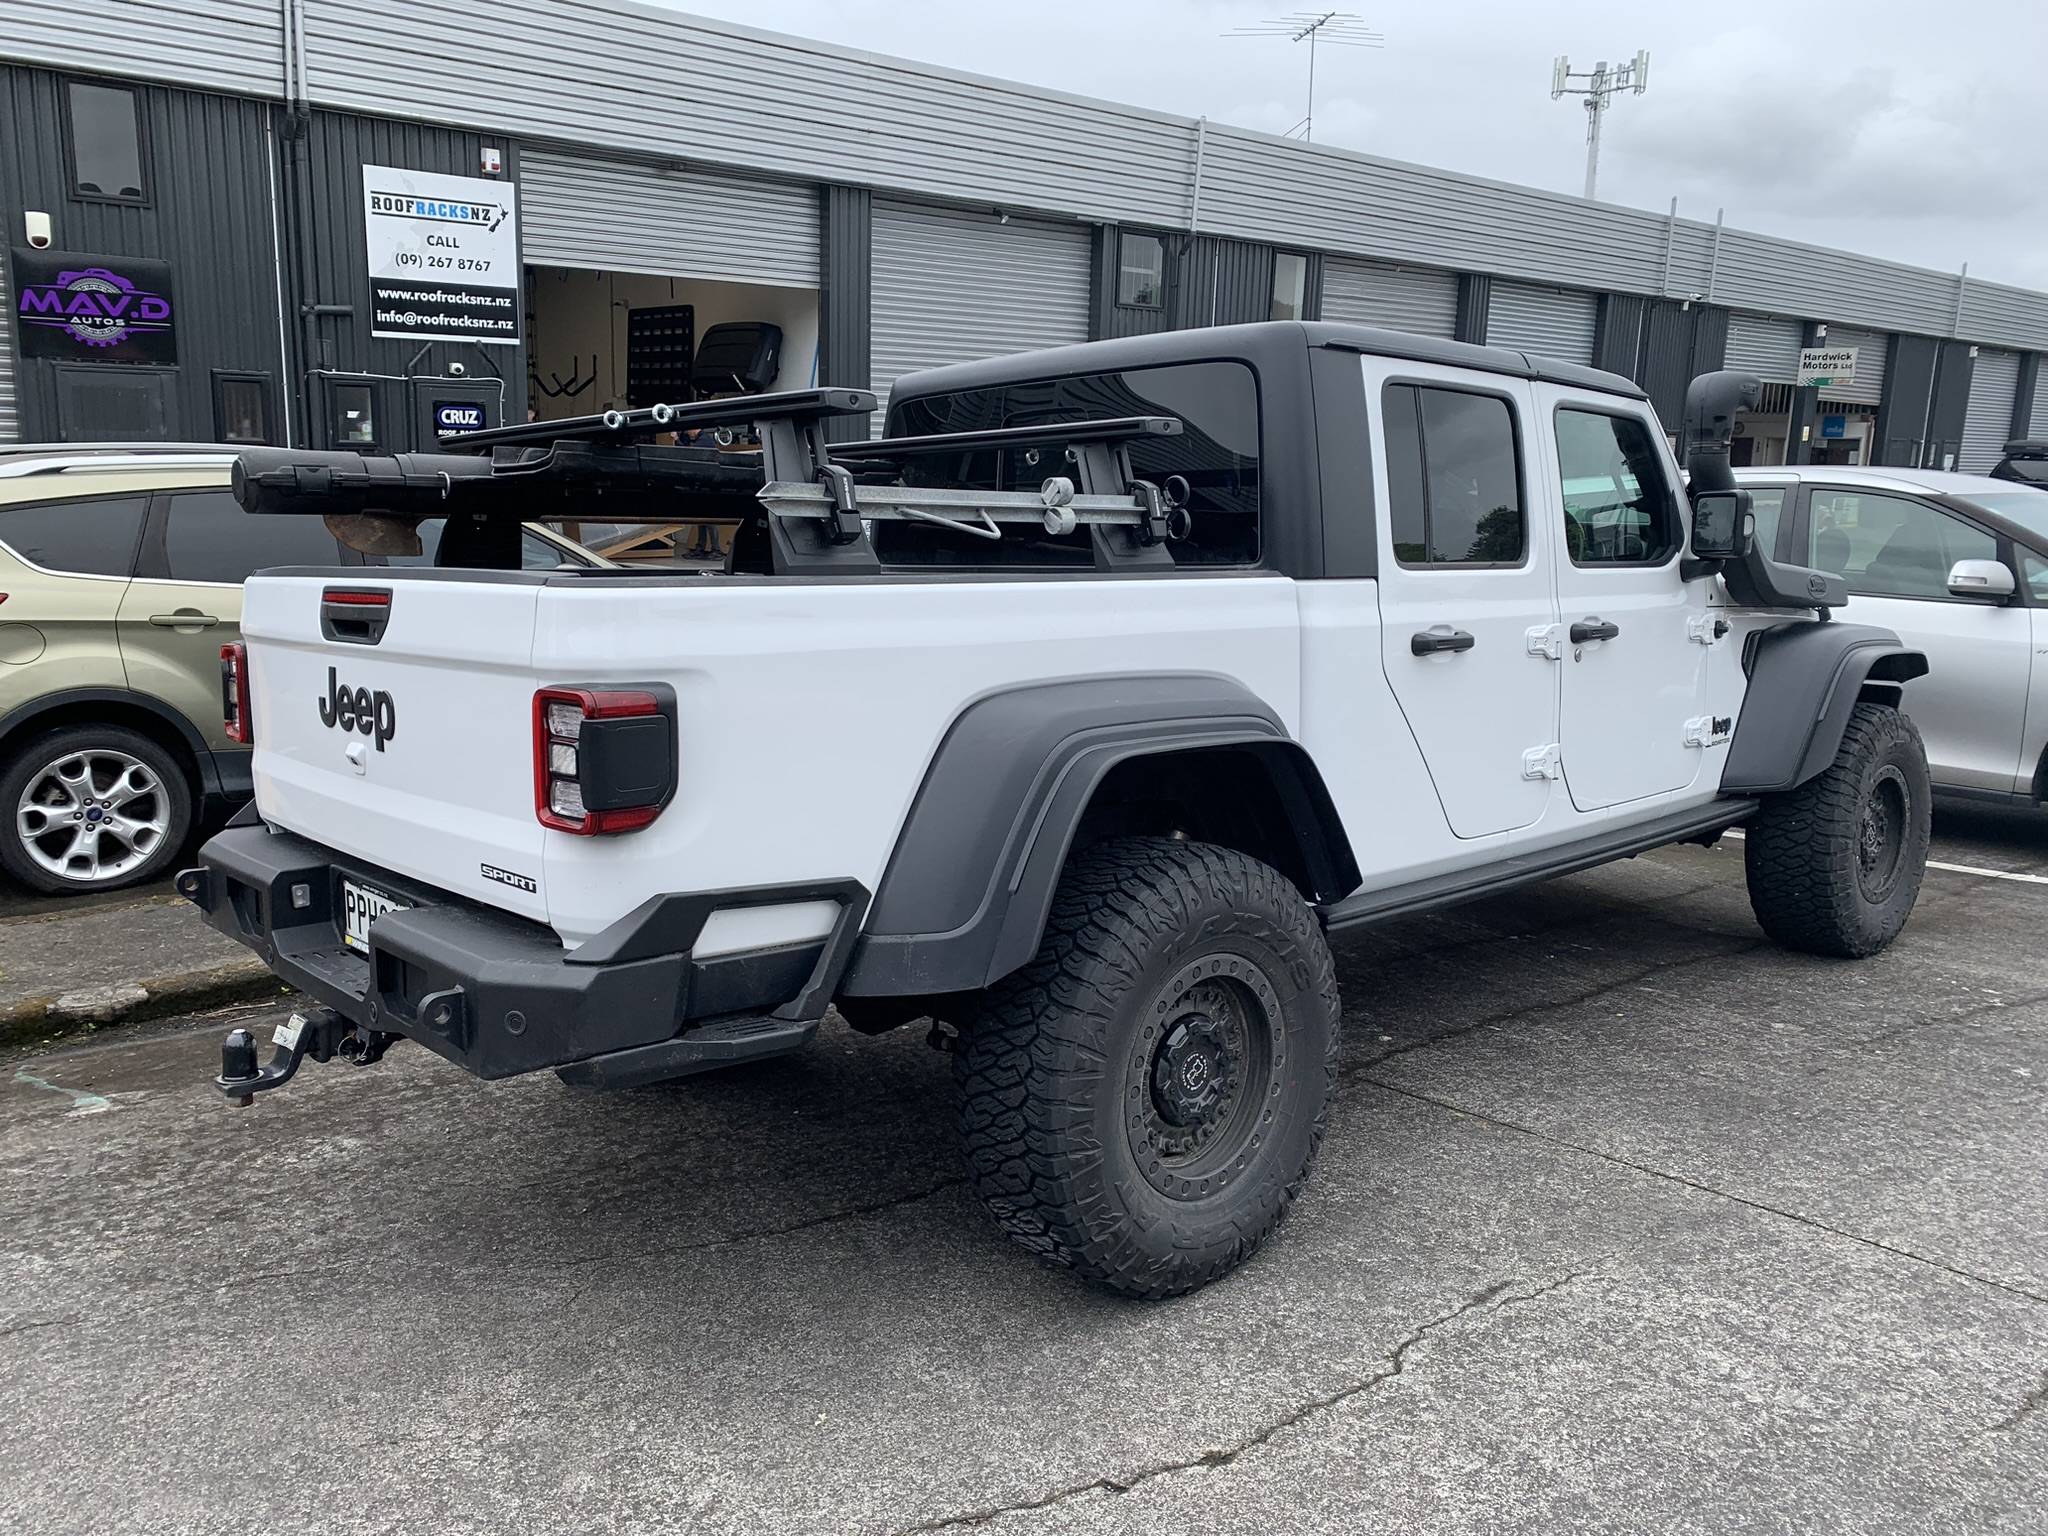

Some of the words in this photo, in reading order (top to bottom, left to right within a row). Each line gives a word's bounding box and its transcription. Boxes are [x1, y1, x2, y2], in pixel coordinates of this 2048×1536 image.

[371, 195, 491, 222] ROOFRACKSNZ
[426, 235, 460, 248] CALL
[395, 253, 423, 269] (09)
[427, 256, 453, 269] 267
[458, 259, 491, 272] 8767
[19, 288, 170, 319] MAV.D
[377, 288, 512, 307] www.roofracksnz.nz
[70, 316, 126, 326] AUTOS
[376, 310, 514, 330] info@roofracksnz.nz
[1802, 361, 1839, 370] Motors
[1803, 352, 1853, 361] Hardwick
[441, 409, 478, 425] CRUZ
[318, 665, 396, 753] Jeep
[481, 864, 537, 891] SPORT
